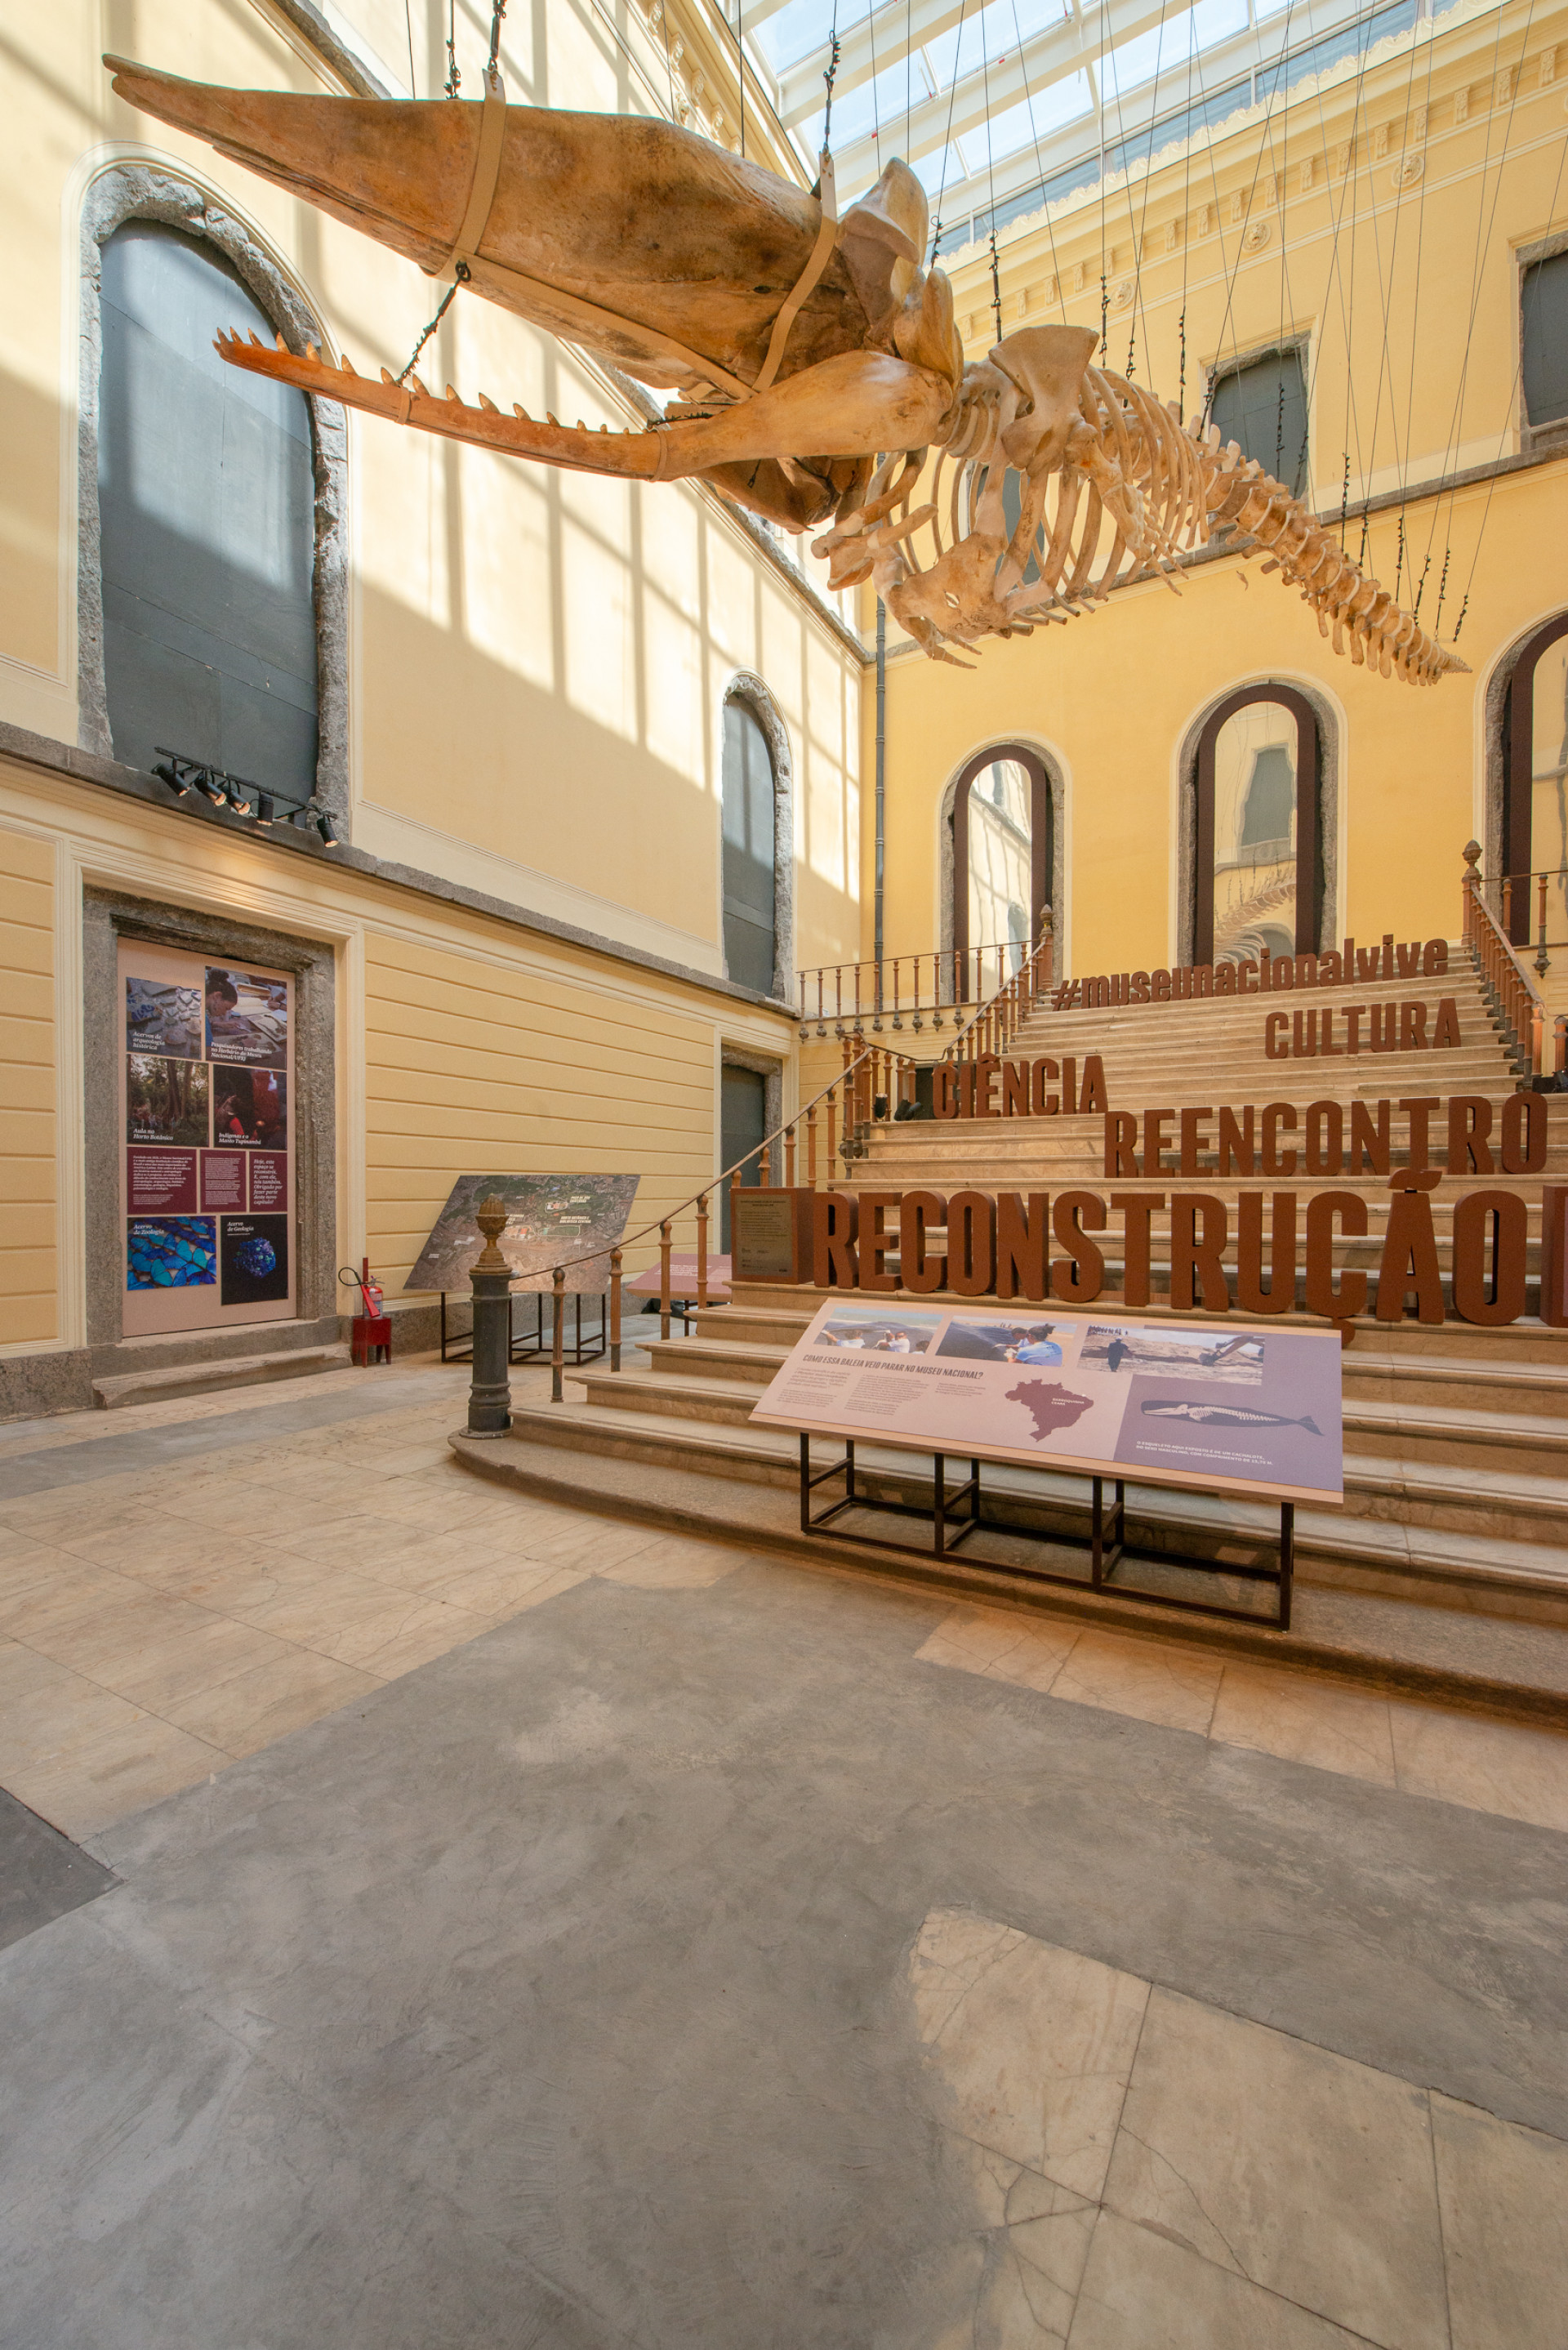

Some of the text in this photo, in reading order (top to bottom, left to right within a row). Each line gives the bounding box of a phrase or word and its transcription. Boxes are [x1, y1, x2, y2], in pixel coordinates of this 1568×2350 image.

[1051, 934, 1449, 1012] #museunacionalvive
[132, 1037, 165, 1046] arqueologia
[211, 1041, 243, 1050] Pesquisadores
[1265, 997, 1462, 1059] CULTURA
[933, 1050, 1109, 1120] CIÊNCIA
[1104, 1092, 1548, 1178] REENCONTRO
[813, 1169, 1528, 1349] RECONSTRUÇÃO
[803, 1354, 822, 1362] COMO
[840, 1358, 864, 1367] BALEIA
[881, 1362, 906, 1371] PARAR
[915, 1366, 942, 1376] MUSEU
[942, 1369, 984, 1380] NACIONAL?
[1158, 1447, 1190, 1456] MASCULINO,
[1202, 1452, 1242, 1461] COMPRIMENTO
[1232, 1451, 1265, 1460] CACHALOTE,
